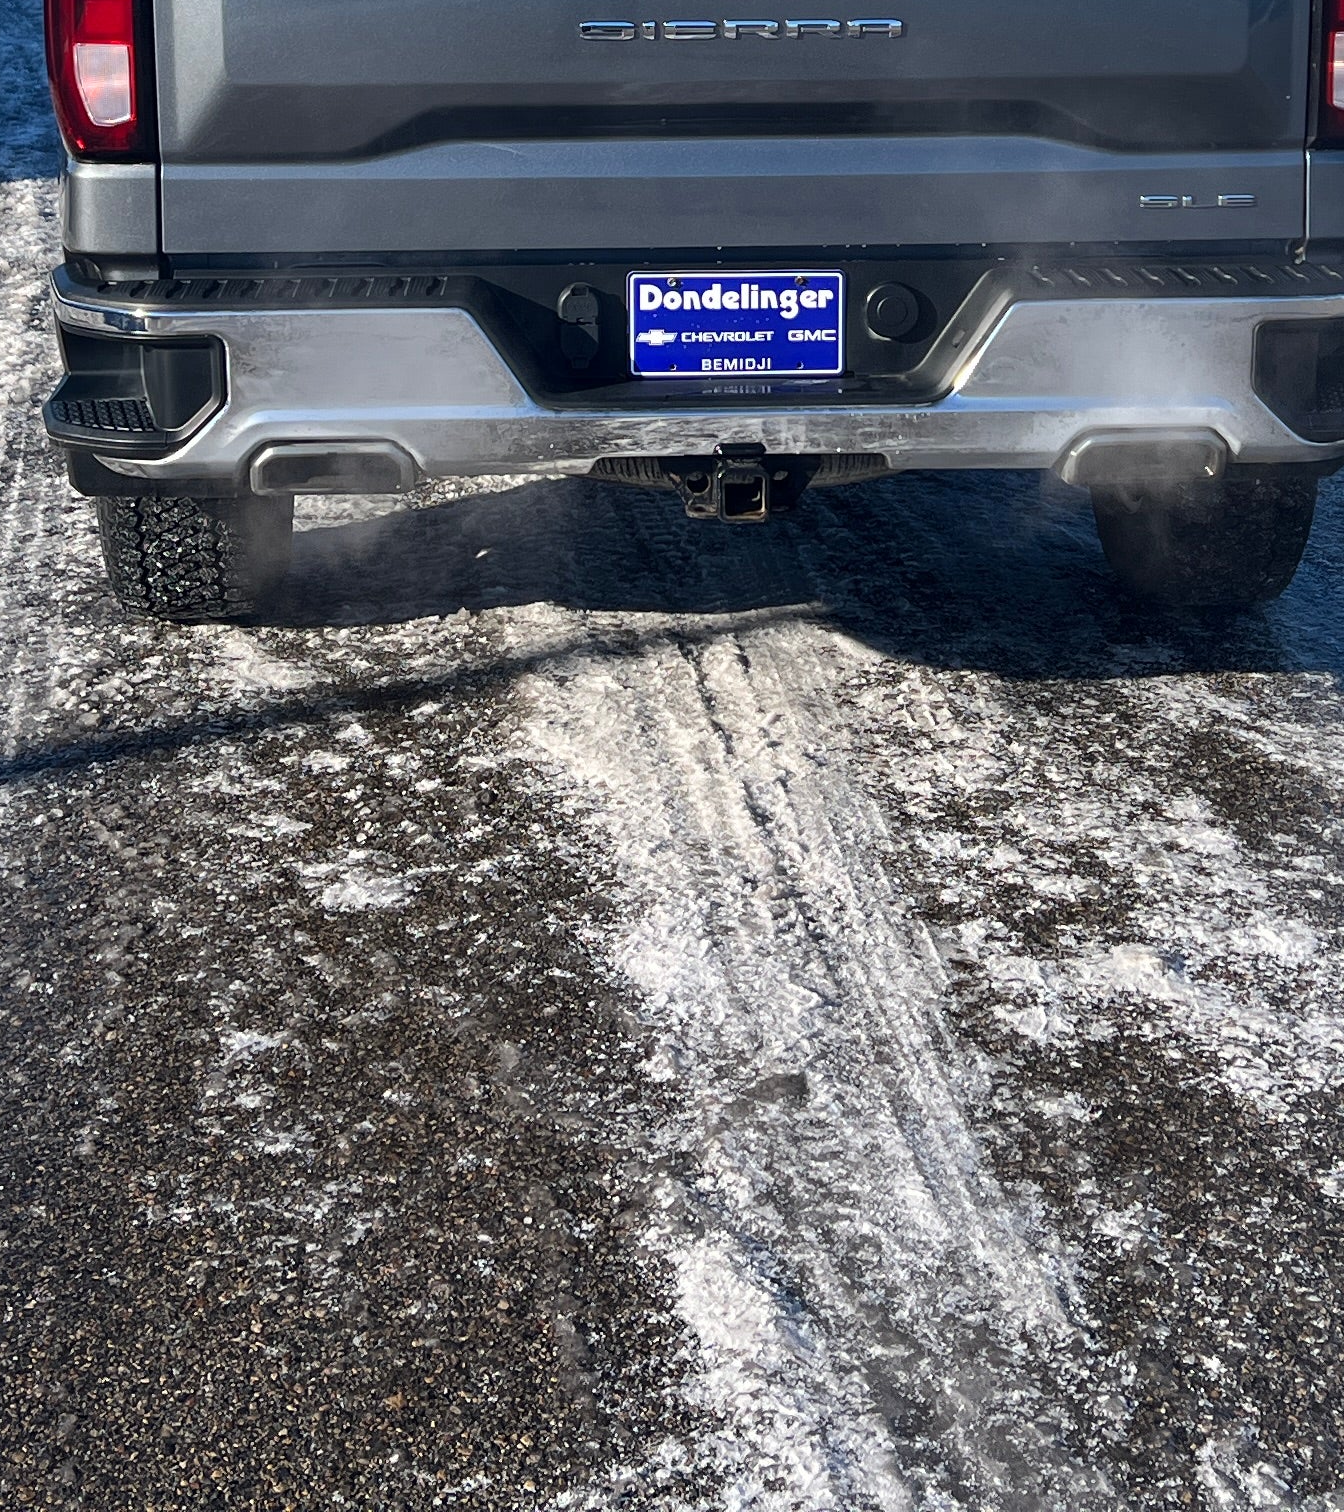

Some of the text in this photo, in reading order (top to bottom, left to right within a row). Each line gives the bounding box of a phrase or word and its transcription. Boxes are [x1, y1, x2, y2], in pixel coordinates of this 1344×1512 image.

[579, 19, 903, 40] SIERRA
[1139, 194, 1256, 208] SLE
[639, 283, 834, 319] Dondelinger
[681, 329, 837, 343] CHEVROLET GMC
[701, 357, 772, 371] BEMIDJI
